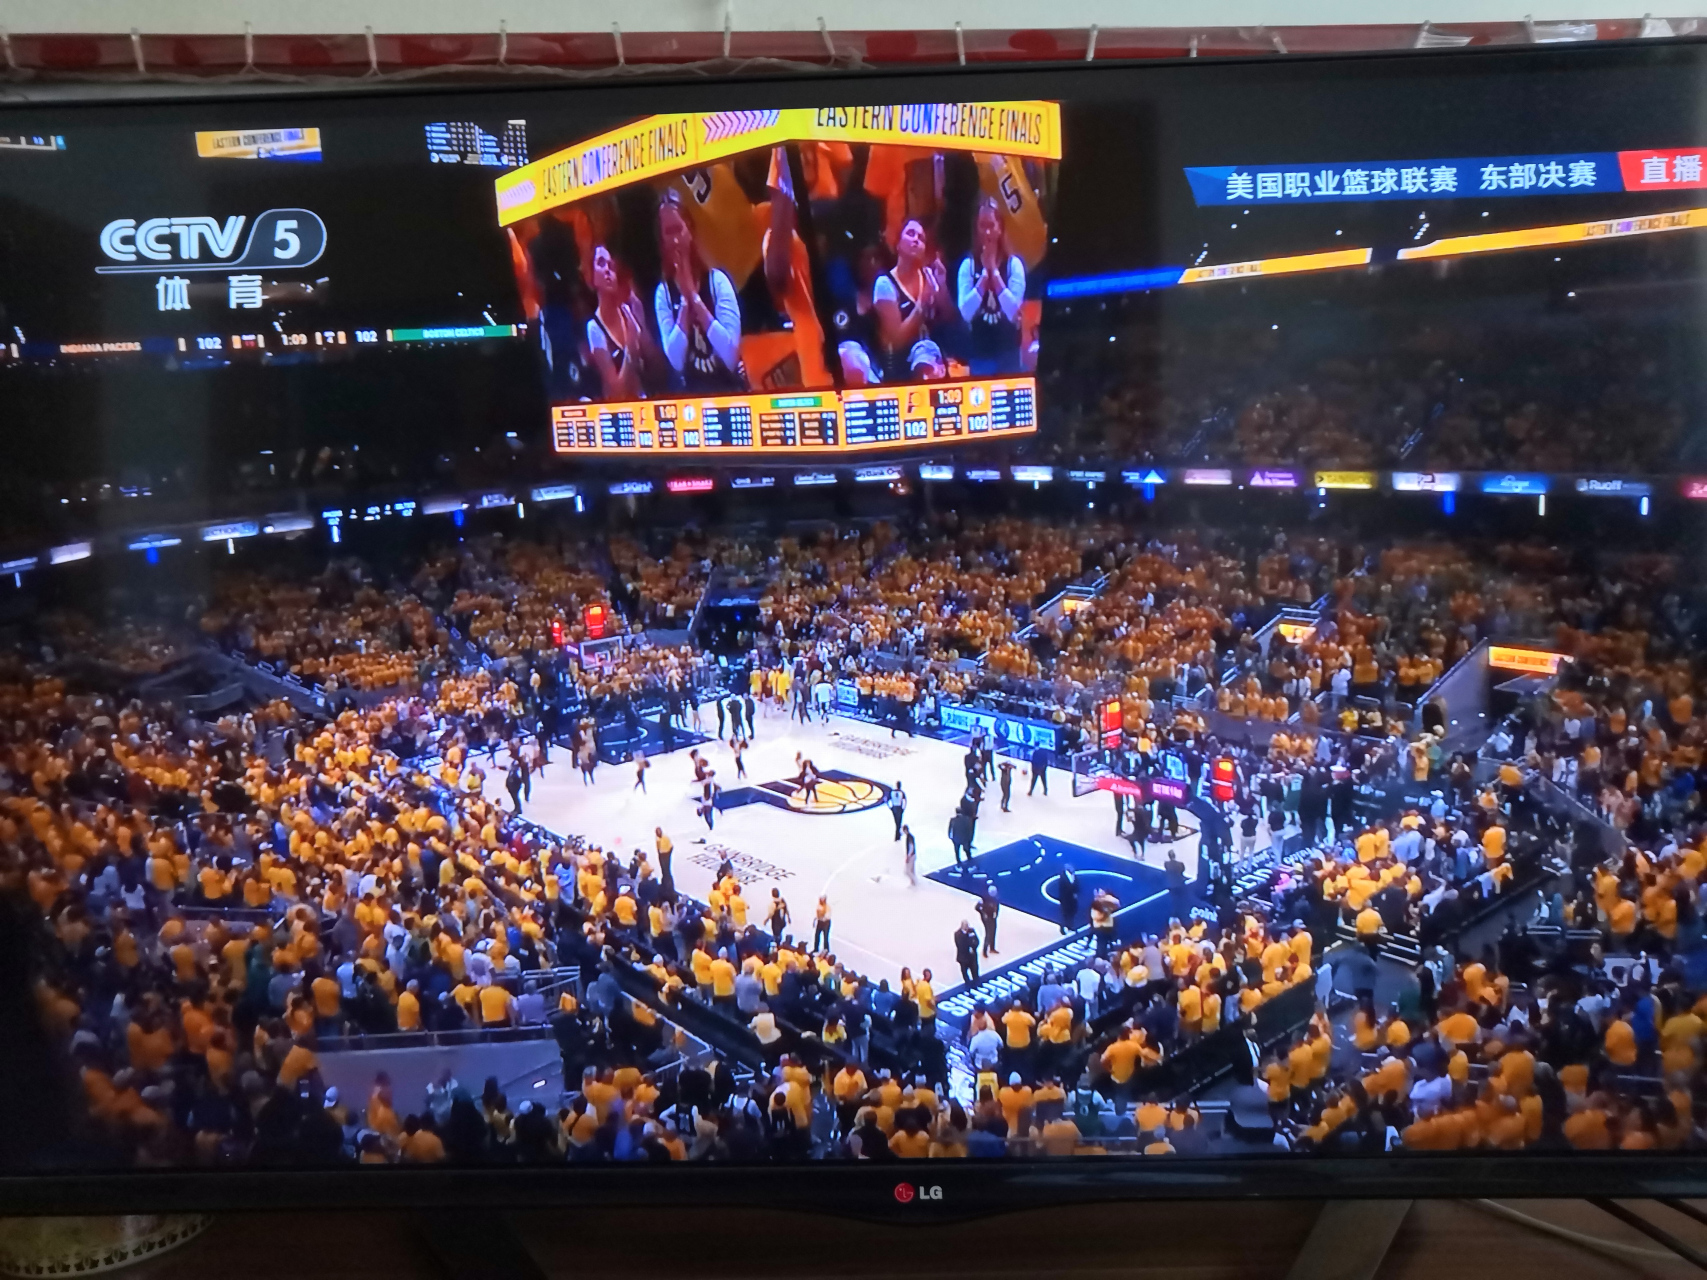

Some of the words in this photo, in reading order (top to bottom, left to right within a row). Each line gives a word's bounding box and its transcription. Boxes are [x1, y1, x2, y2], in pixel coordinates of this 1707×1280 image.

[817, 103, 893, 131] EASTERN
[900, 103, 994, 139] CONFERENCE
[998, 108, 1042, 145] FINALS
[582, 133, 645, 186] CONFERENCE
[649, 118, 688, 166] FINALS
[1640, 154, 1703, 184] 直播
[1226, 166, 1458, 200] 美国职业篮球联赛
[1479, 160, 1597, 190] 东部决赛
[100, 215, 246, 261] CCTV
[273, 219, 301, 259] 5
[196, 337, 223, 350] 102
[280, 333, 308, 346] 1:09
[355, 330, 379, 342] 102
[937, 388, 963, 404] 1:09
[904, 421, 927, 437] 102
[967, 415, 989, 431] 102
[919, 1185, 943, 1200] LG
